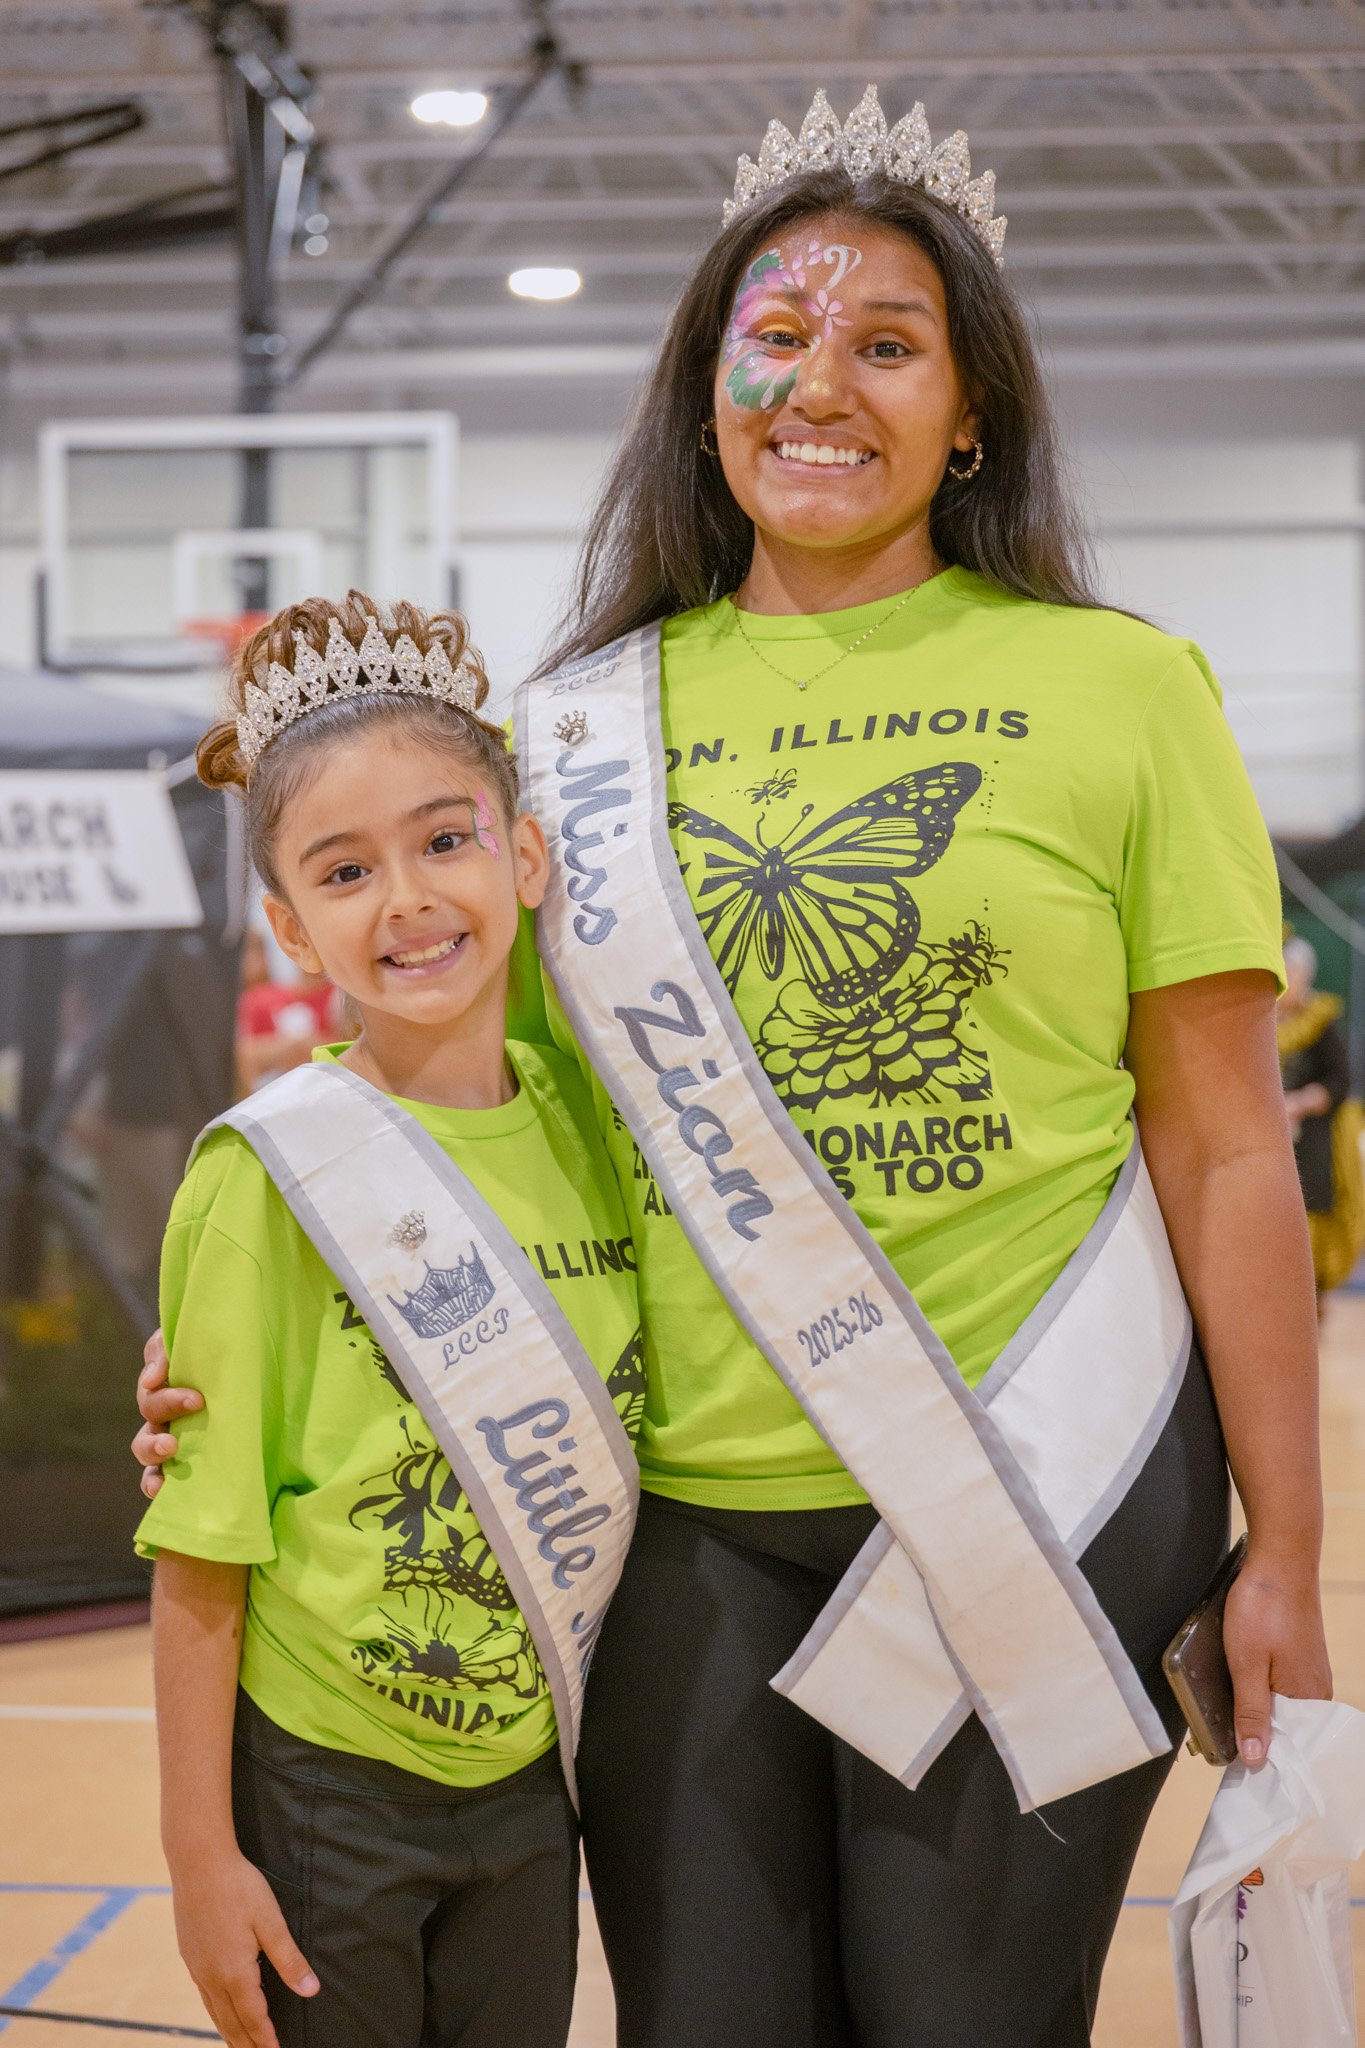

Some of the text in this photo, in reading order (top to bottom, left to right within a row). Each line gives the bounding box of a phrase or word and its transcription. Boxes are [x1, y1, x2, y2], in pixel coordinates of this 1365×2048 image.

[769, 707, 1029, 753] ILLINOIS
[0, 800, 114, 849] RCH
[555, 750, 774, 1242] Miss Zion
[873, 1153, 984, 1197] TOO
[796, 1289, 883, 1368] 2025-26
[475, 1397, 612, 1590] Little
